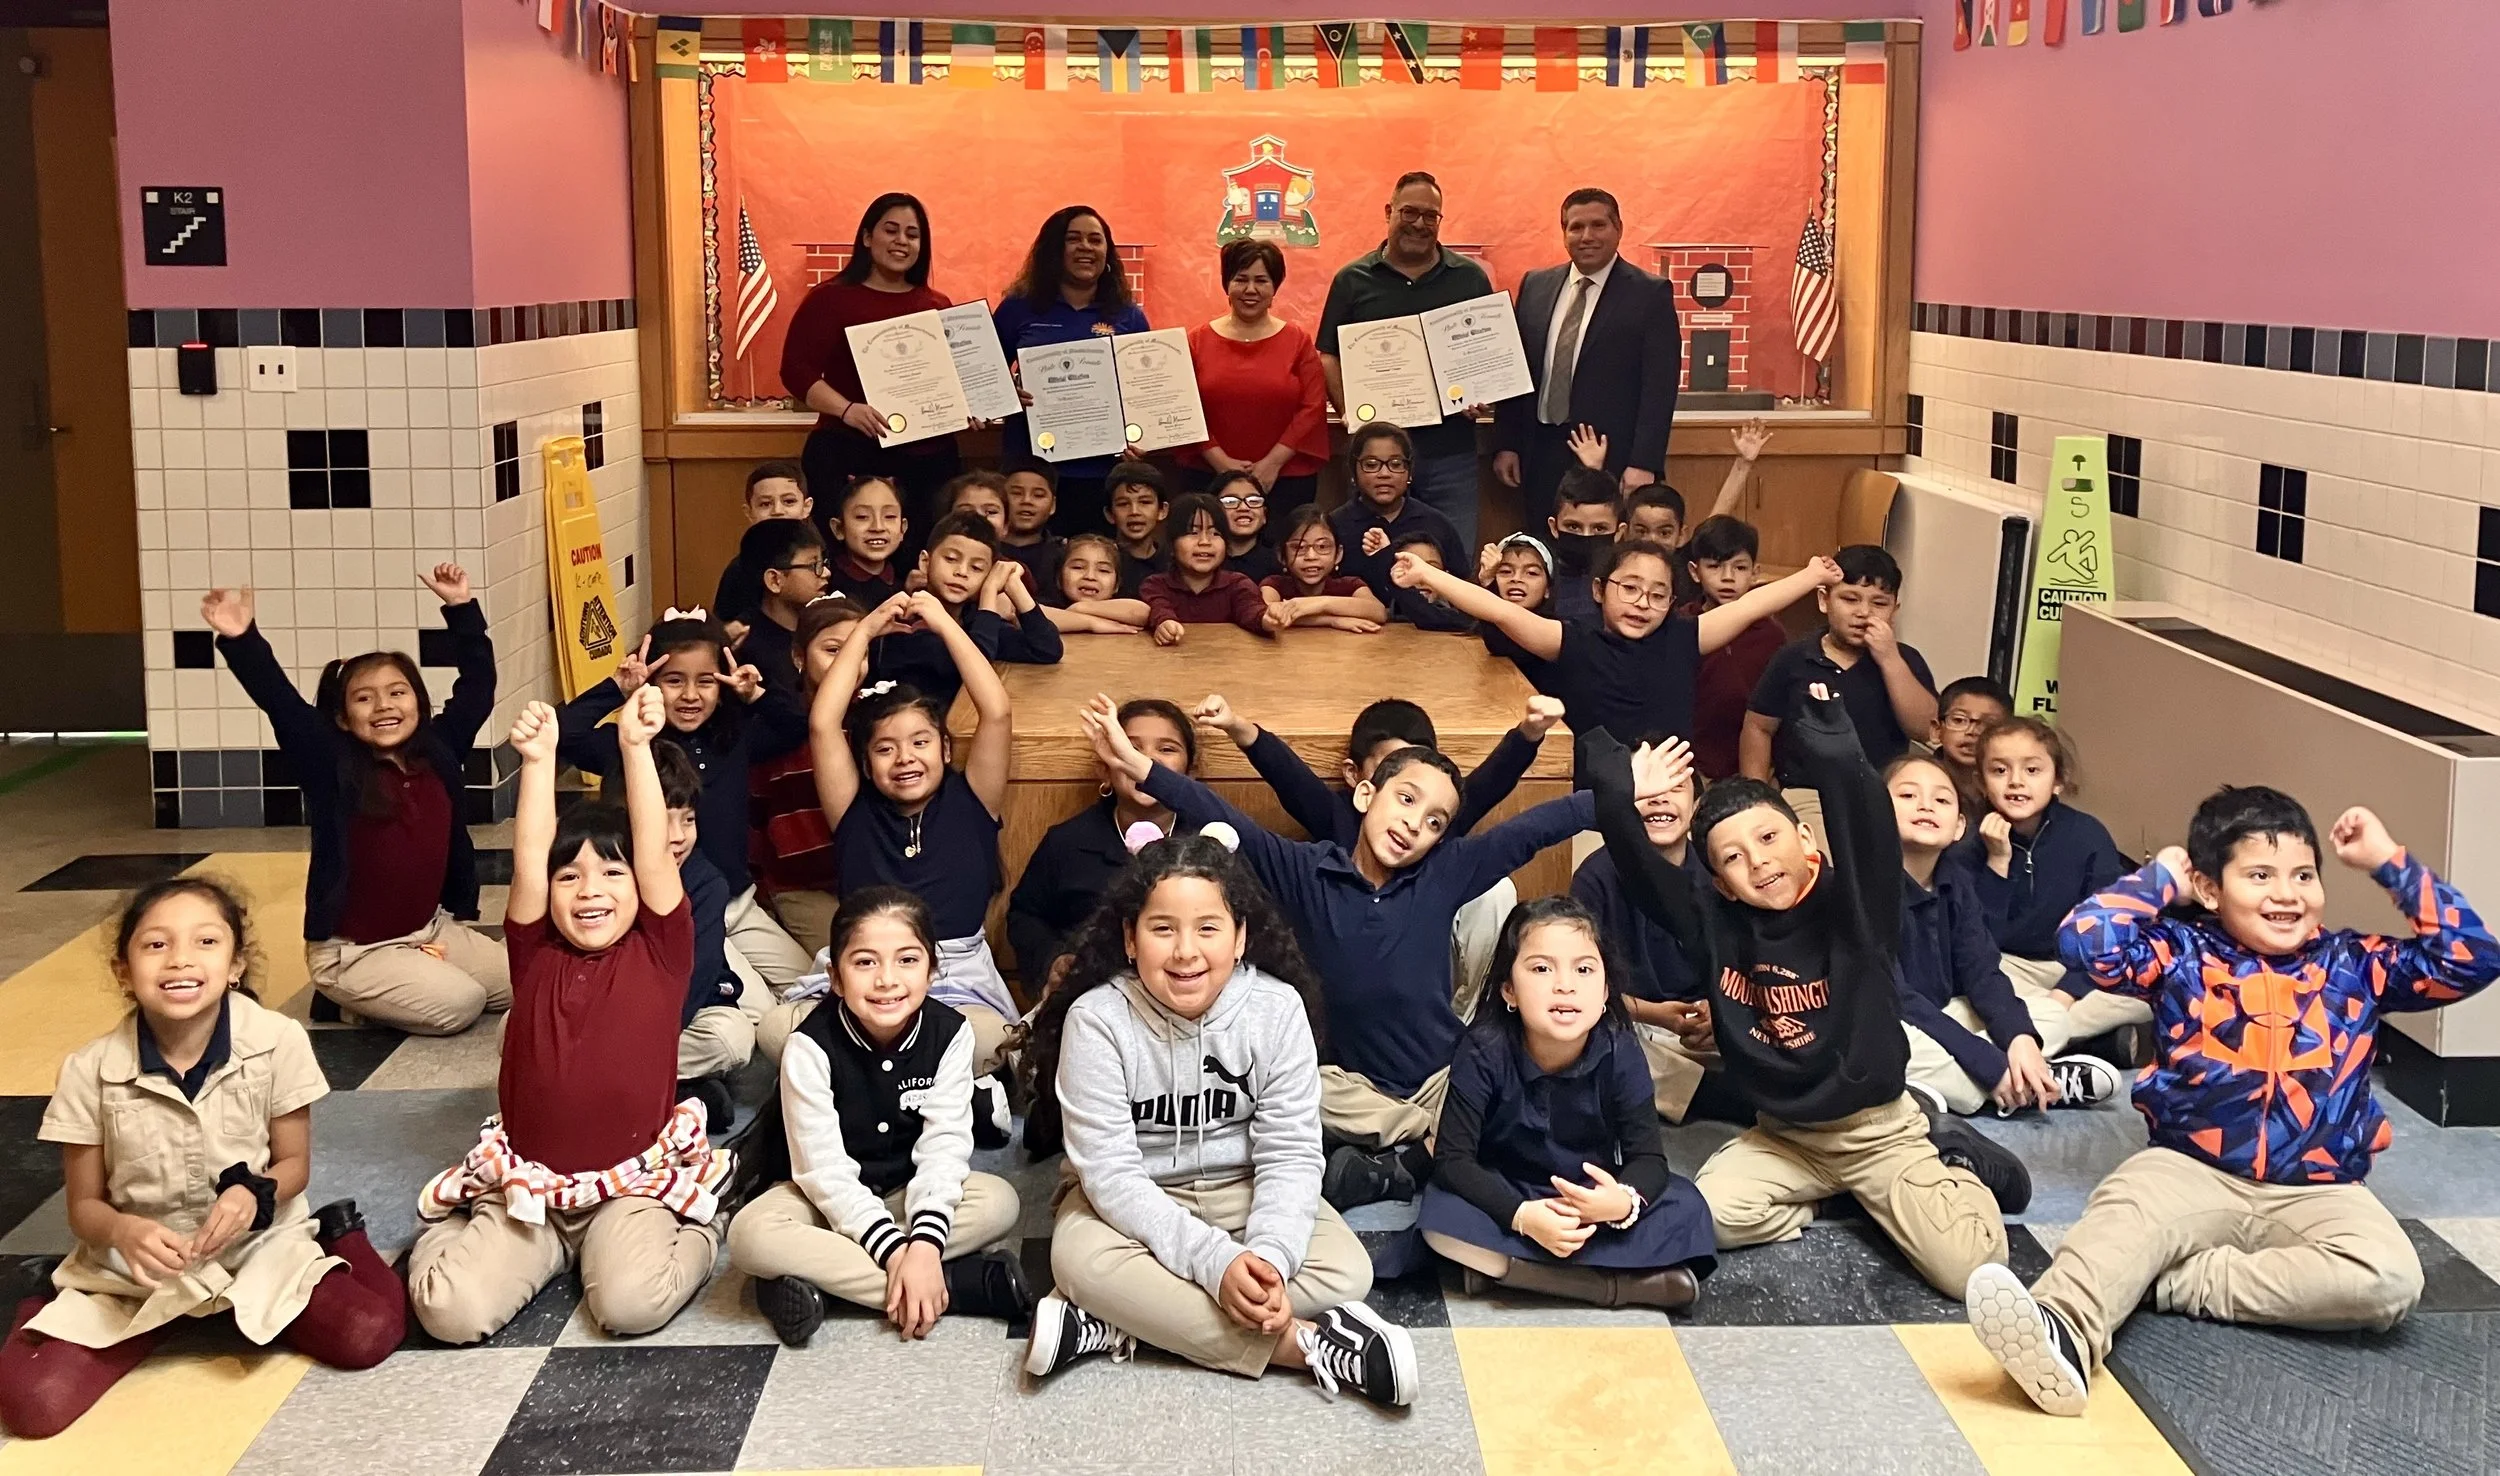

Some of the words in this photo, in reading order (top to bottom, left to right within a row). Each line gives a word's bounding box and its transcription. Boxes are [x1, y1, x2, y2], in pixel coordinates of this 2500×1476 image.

[174, 192, 193, 204] K2
[170, 207, 196, 215] STAIR
[571, 543, 602, 566] CAUTION
[2040, 589, 2105, 604] CAUTION
[2039, 605, 2063, 620] CU
[2033, 697, 2057, 712] FL
[1131, 1088, 1237, 1127] PUMA
